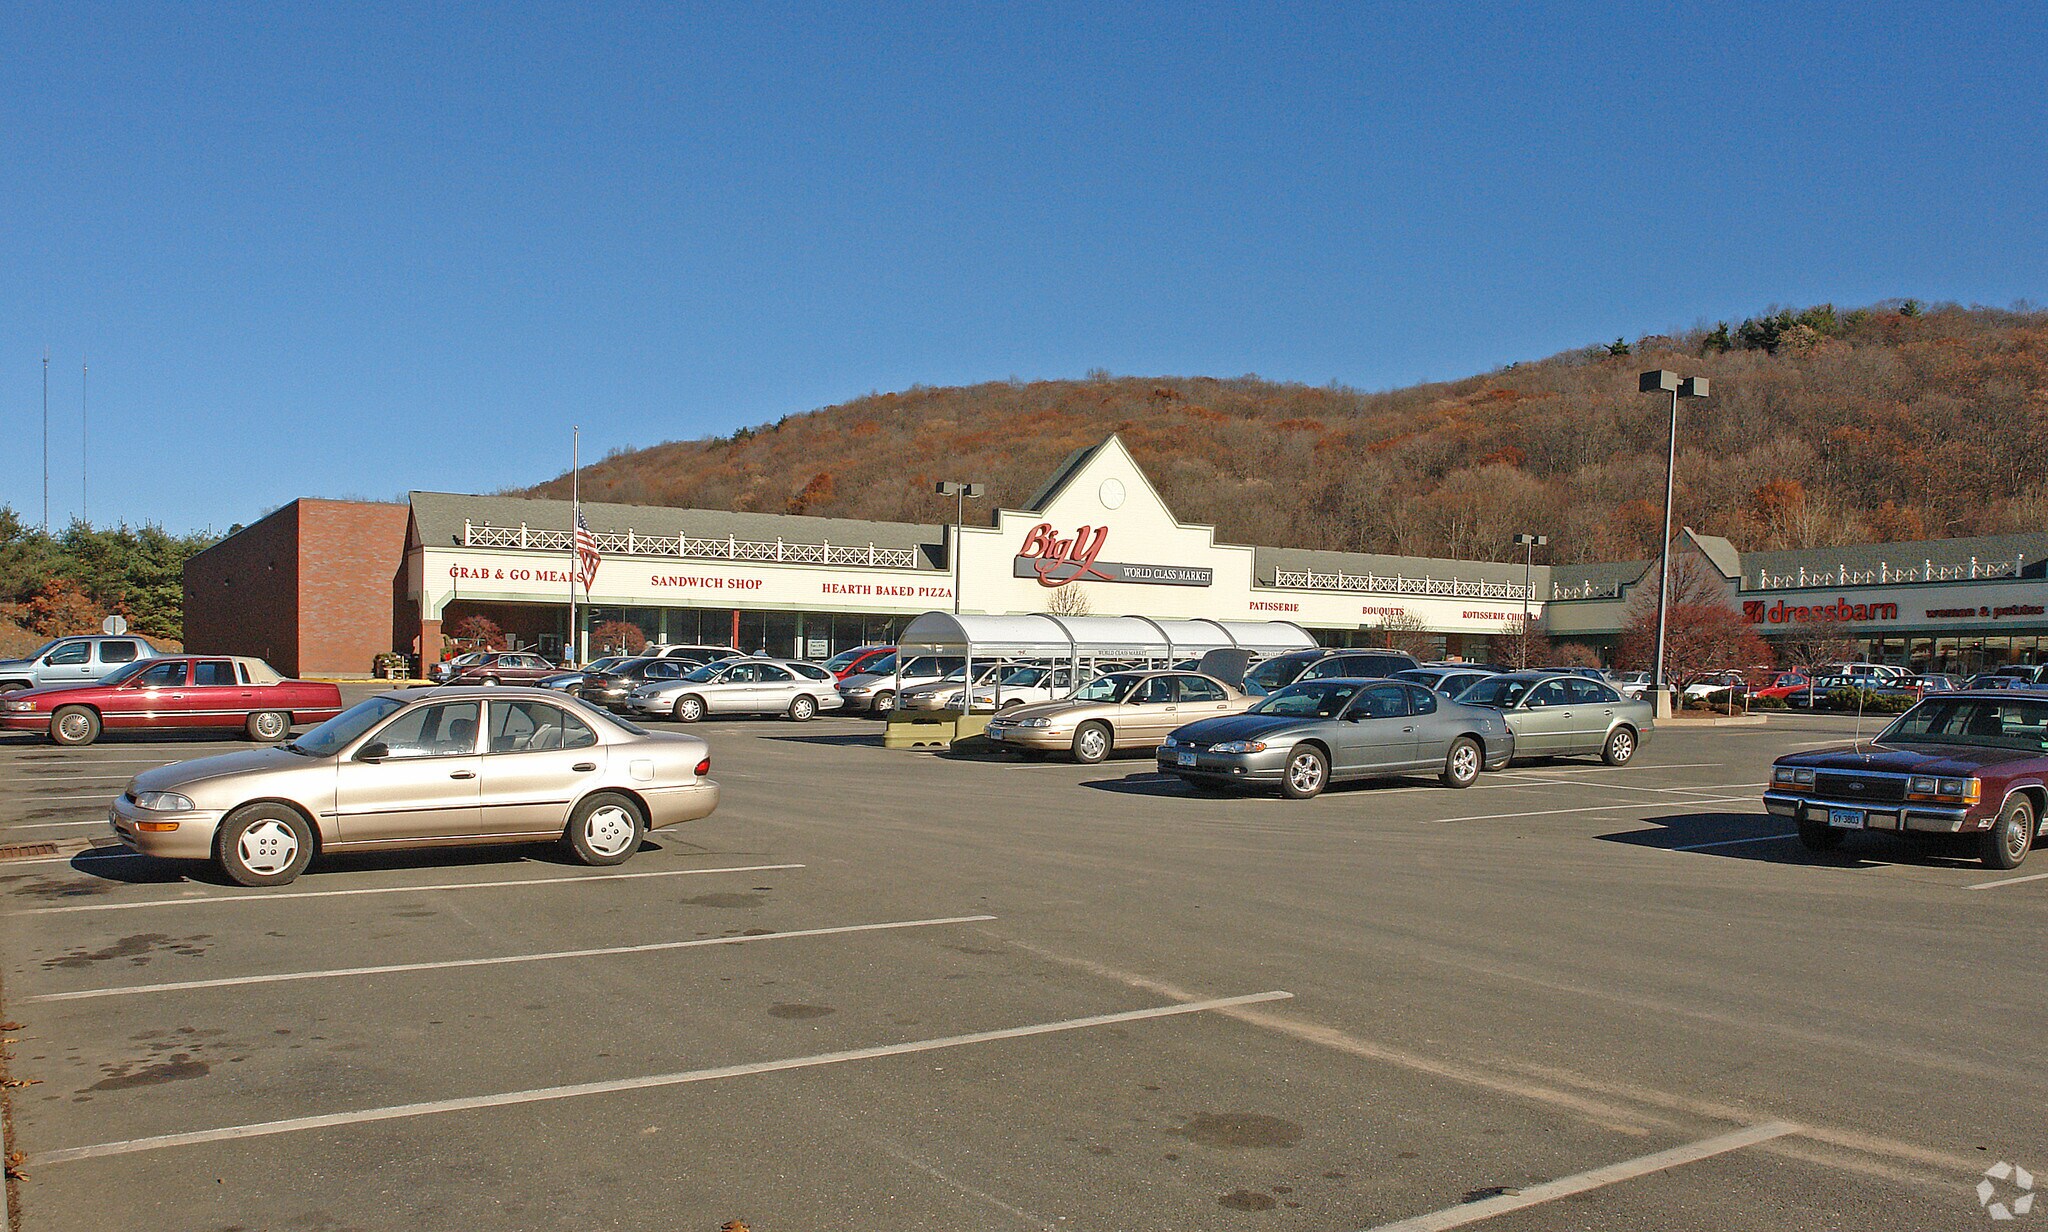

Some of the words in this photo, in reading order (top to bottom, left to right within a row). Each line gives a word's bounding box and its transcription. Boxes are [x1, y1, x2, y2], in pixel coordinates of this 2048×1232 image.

[1017, 523, 1074, 574] Big
[449, 566, 490, 579] GRAB
[494, 568, 505, 580] &
[509, 569, 530, 581] GO
[1123, 567, 1152, 579] WORLD
[1154, 568, 1177, 580] CLASS
[1179, 570, 1211, 582] MARKET
[651, 575, 723, 589] SANDWICH
[727, 578, 763, 590] SHOP
[822, 583, 871, 595] HEARTH
[876, 585, 915, 597] BAKED
[918, 587, 953, 598] PIZZA
[1249, 601, 1300, 612] PATISSERIE
[1362, 606, 1405, 616] BOUQUETS
[1767, 597, 1897, 624] dressbarn
[1979, 606, 1990, 617] &
[1462, 610, 1505, 620] ROTISSERIE
